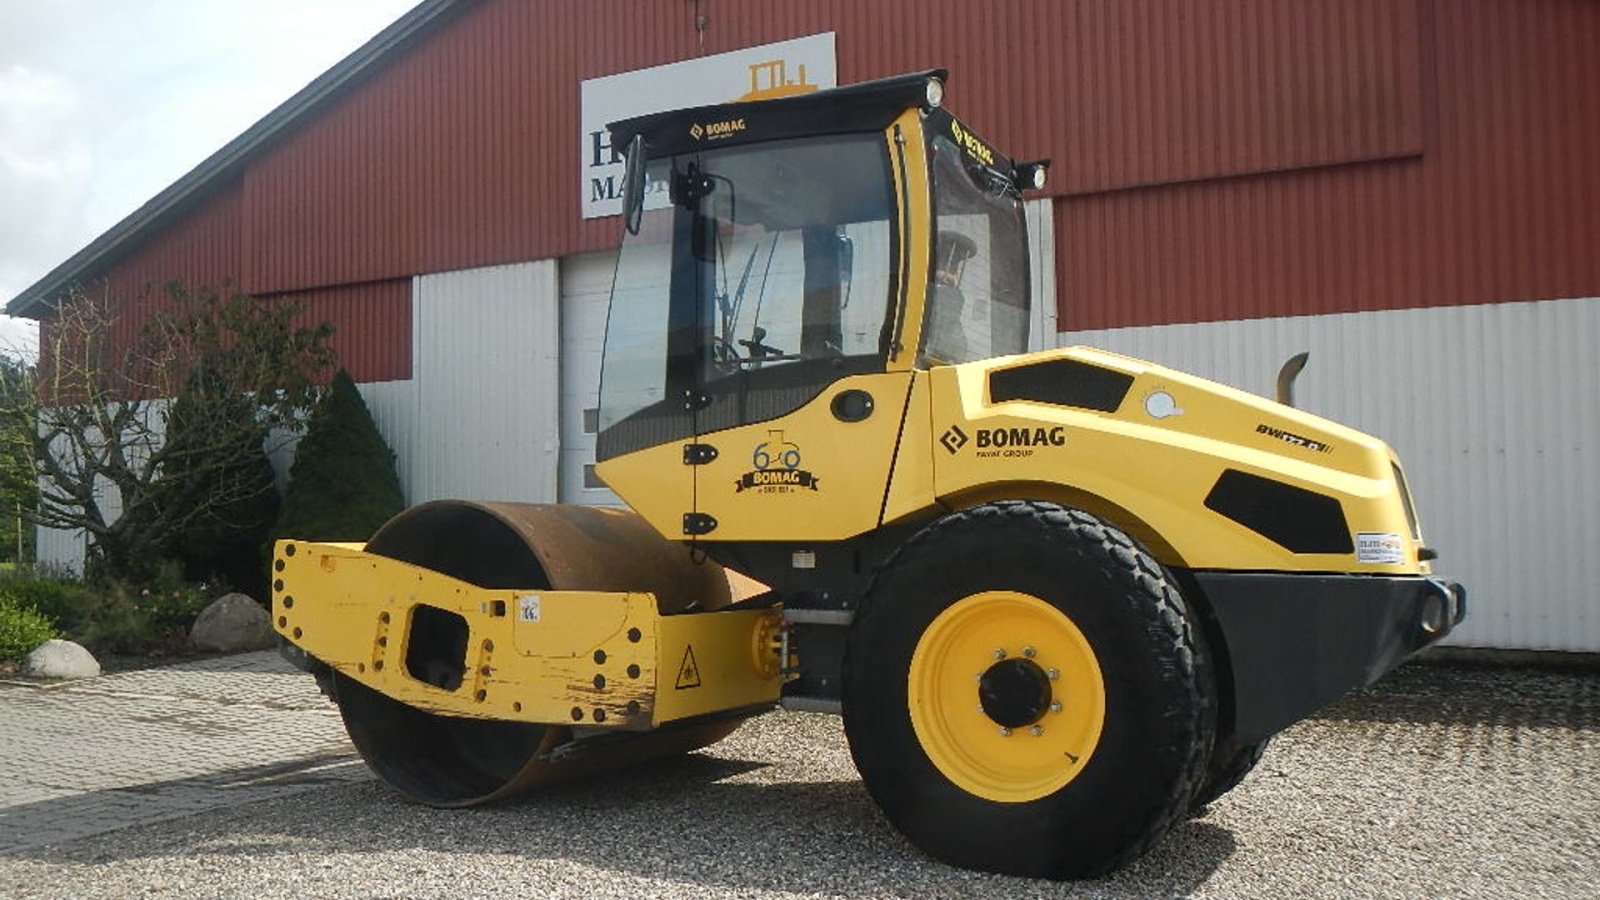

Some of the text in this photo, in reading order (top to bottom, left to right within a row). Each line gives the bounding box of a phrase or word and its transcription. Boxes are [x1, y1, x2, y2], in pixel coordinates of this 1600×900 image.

[706, 119, 745, 135] BOMAG
[976, 427, 1066, 448] BOMAG
[1003, 450, 1034, 458] GROUP
[753, 471, 800, 484] BOMAG
